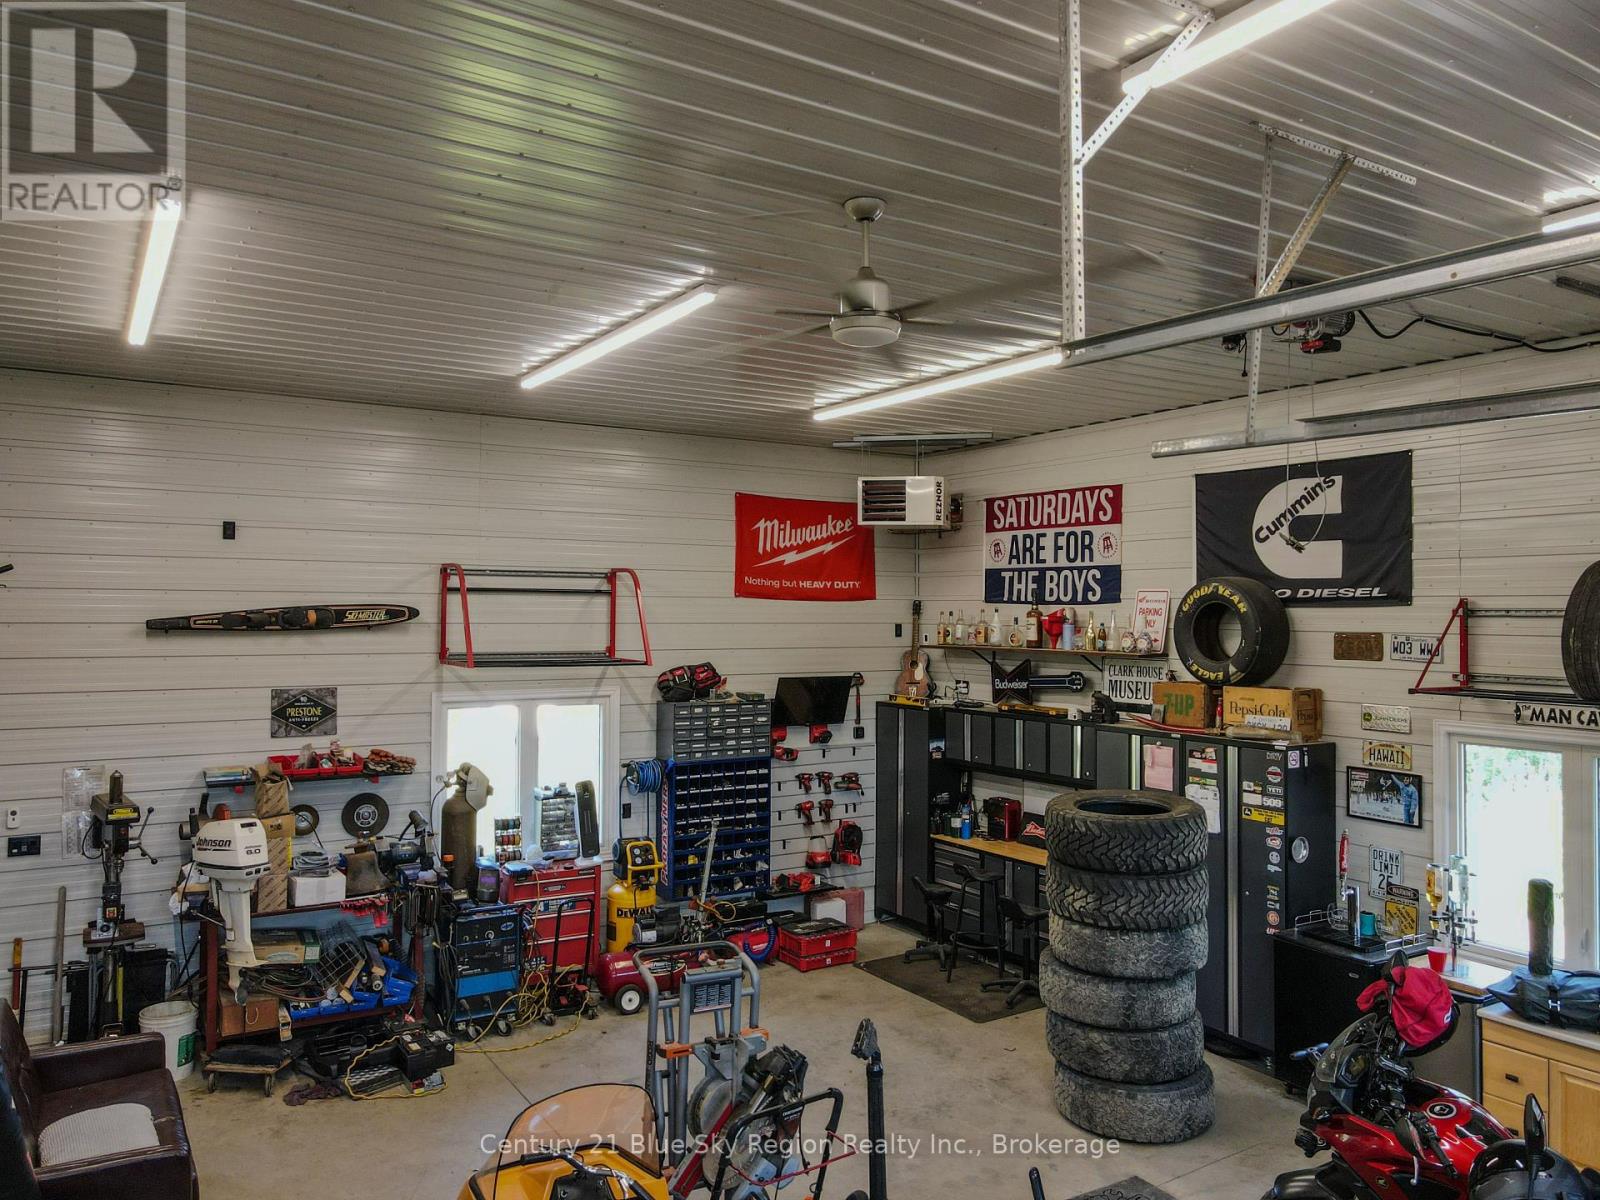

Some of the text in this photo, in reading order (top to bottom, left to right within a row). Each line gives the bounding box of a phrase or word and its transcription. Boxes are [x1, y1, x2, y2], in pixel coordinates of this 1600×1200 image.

[935, 481, 943, 521] REZNOR
[993, 488, 1114, 530] SATURDAYS
[1255, 477, 1336, 544] Cummins
[751, 515, 855, 555] Milwaukee
[1008, 530, 1094, 565] ARE FOR
[744, 576, 861, 589] Nothing but HEAVY DUTY
[1001, 568, 1101, 602] THE BOYS
[1182, 583, 1247, 613] GOODYEAR
[1274, 587, 1388, 598] O DIESEL
[1138, 607, 1163, 616] PARKING
[1108, 664, 1163, 680] CLARK HOUSE
[1190, 663, 1224, 680] EAGLE
[994, 678, 1028, 689] Budweiser
[1108, 680, 1152, 700] MUSEU
[286, 706, 322, 717] PRESTONE
[1229, 700, 1286, 718] Pepsi-Cola
[1530, 707, 1572, 725] MAN
[1577, 709, 1600, 727] CA
[1369, 748, 1405, 764] HAWAII
[1262, 796, 1282, 808] 509
[196, 835, 232, 848] Johnson
[1372, 849, 1400, 864] DRINK
[1372, 860, 1400, 876] LIMIT
